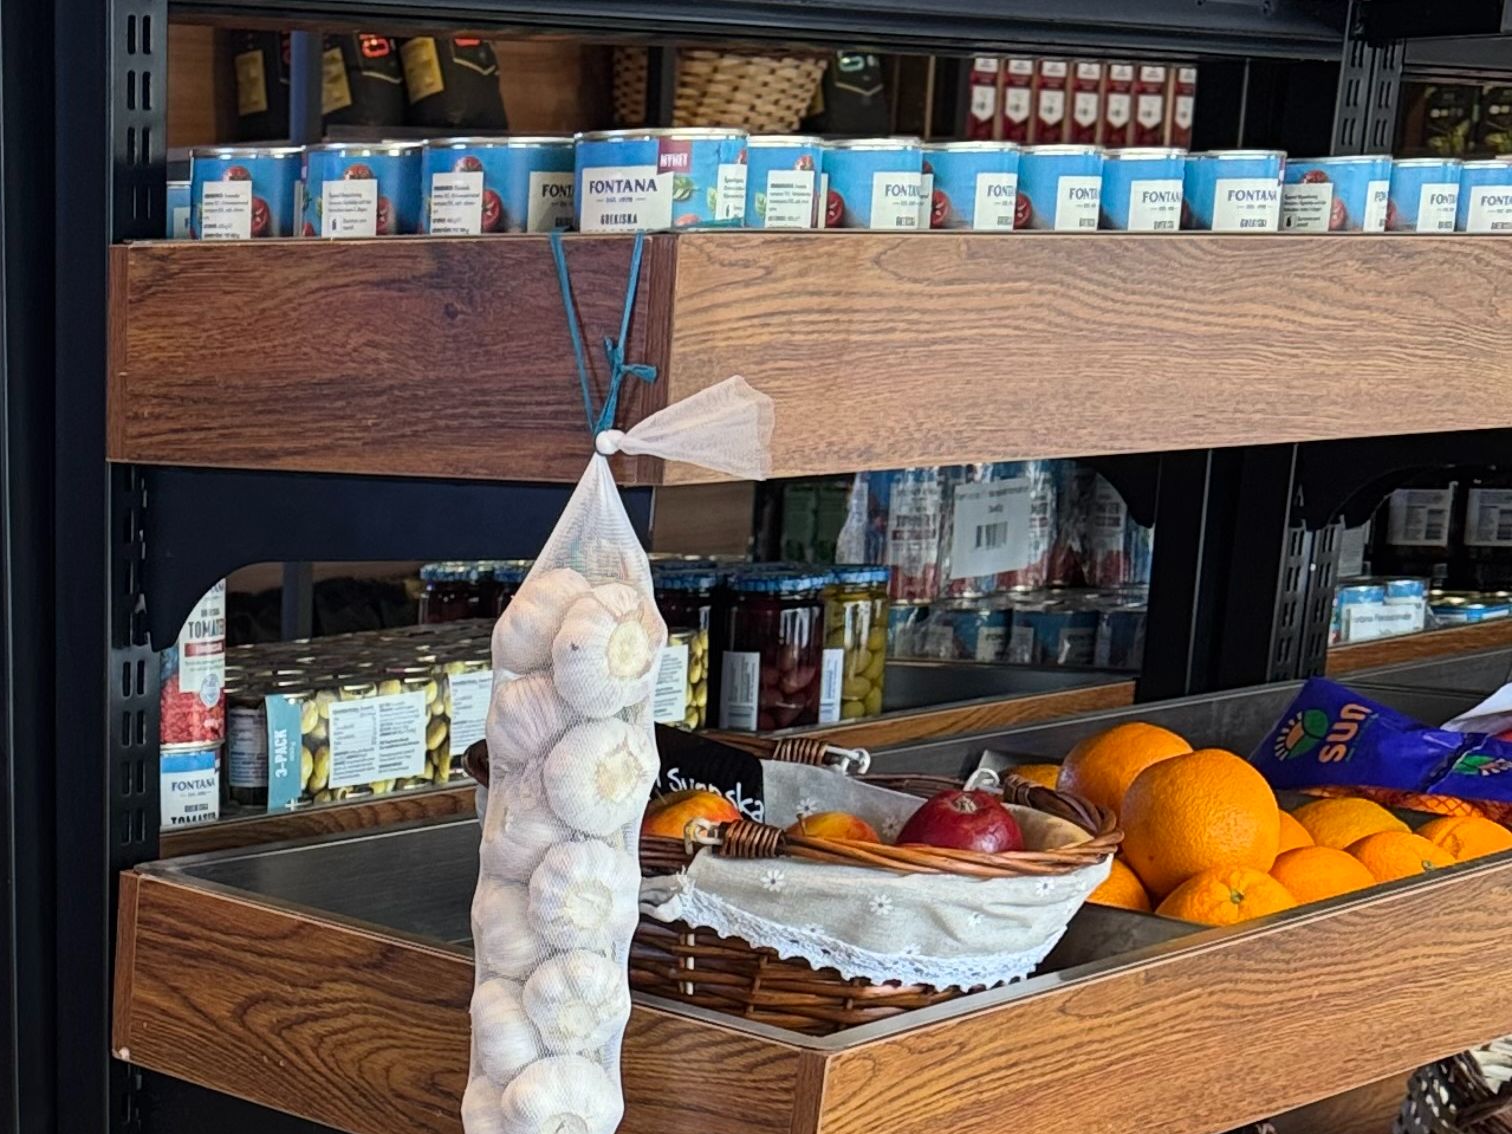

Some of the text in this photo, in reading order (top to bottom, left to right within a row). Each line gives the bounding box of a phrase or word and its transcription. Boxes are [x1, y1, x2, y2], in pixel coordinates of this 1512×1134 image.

[589, 178, 658, 194] FONTANA
[274, 728, 288, 778] 3-PACK
[1318, 703, 1373, 763] sun
